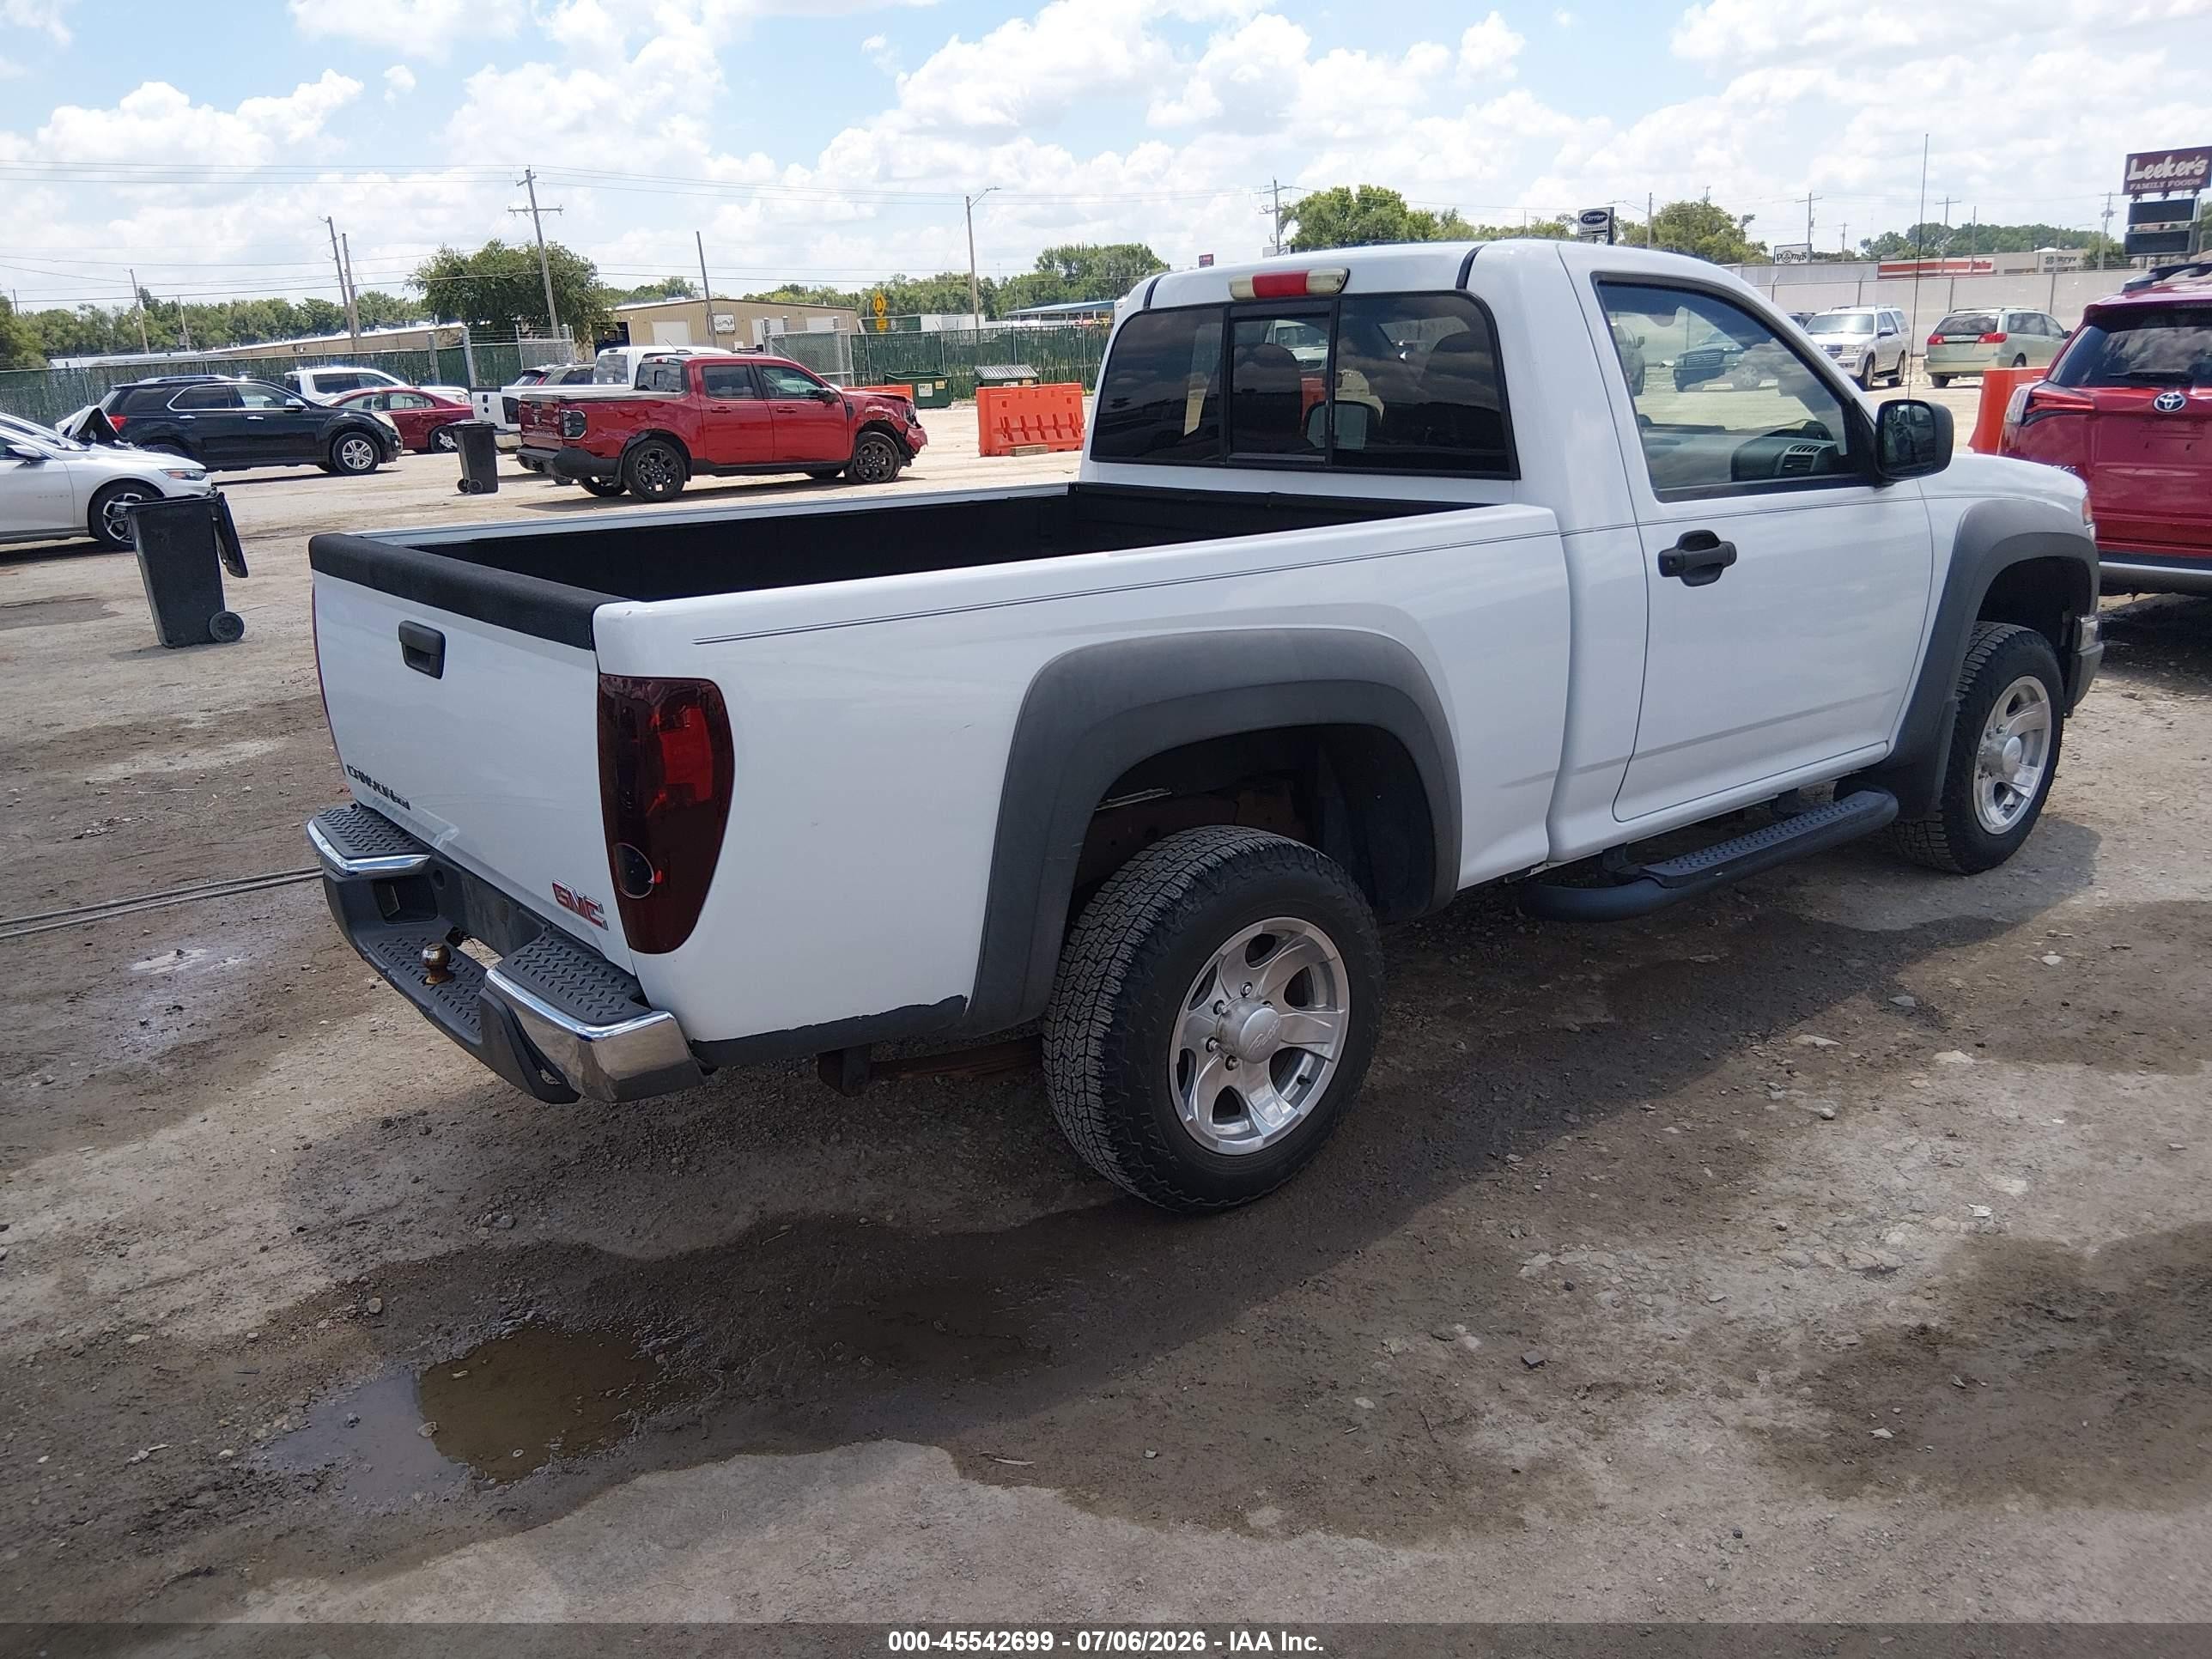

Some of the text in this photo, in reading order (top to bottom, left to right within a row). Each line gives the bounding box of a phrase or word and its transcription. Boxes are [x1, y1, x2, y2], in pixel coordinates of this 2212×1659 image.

[2127, 155, 2209, 180] Leeker's
[2130, 178, 2201, 190] FAMILY FOODS
[552, 878, 609, 931] GMC
